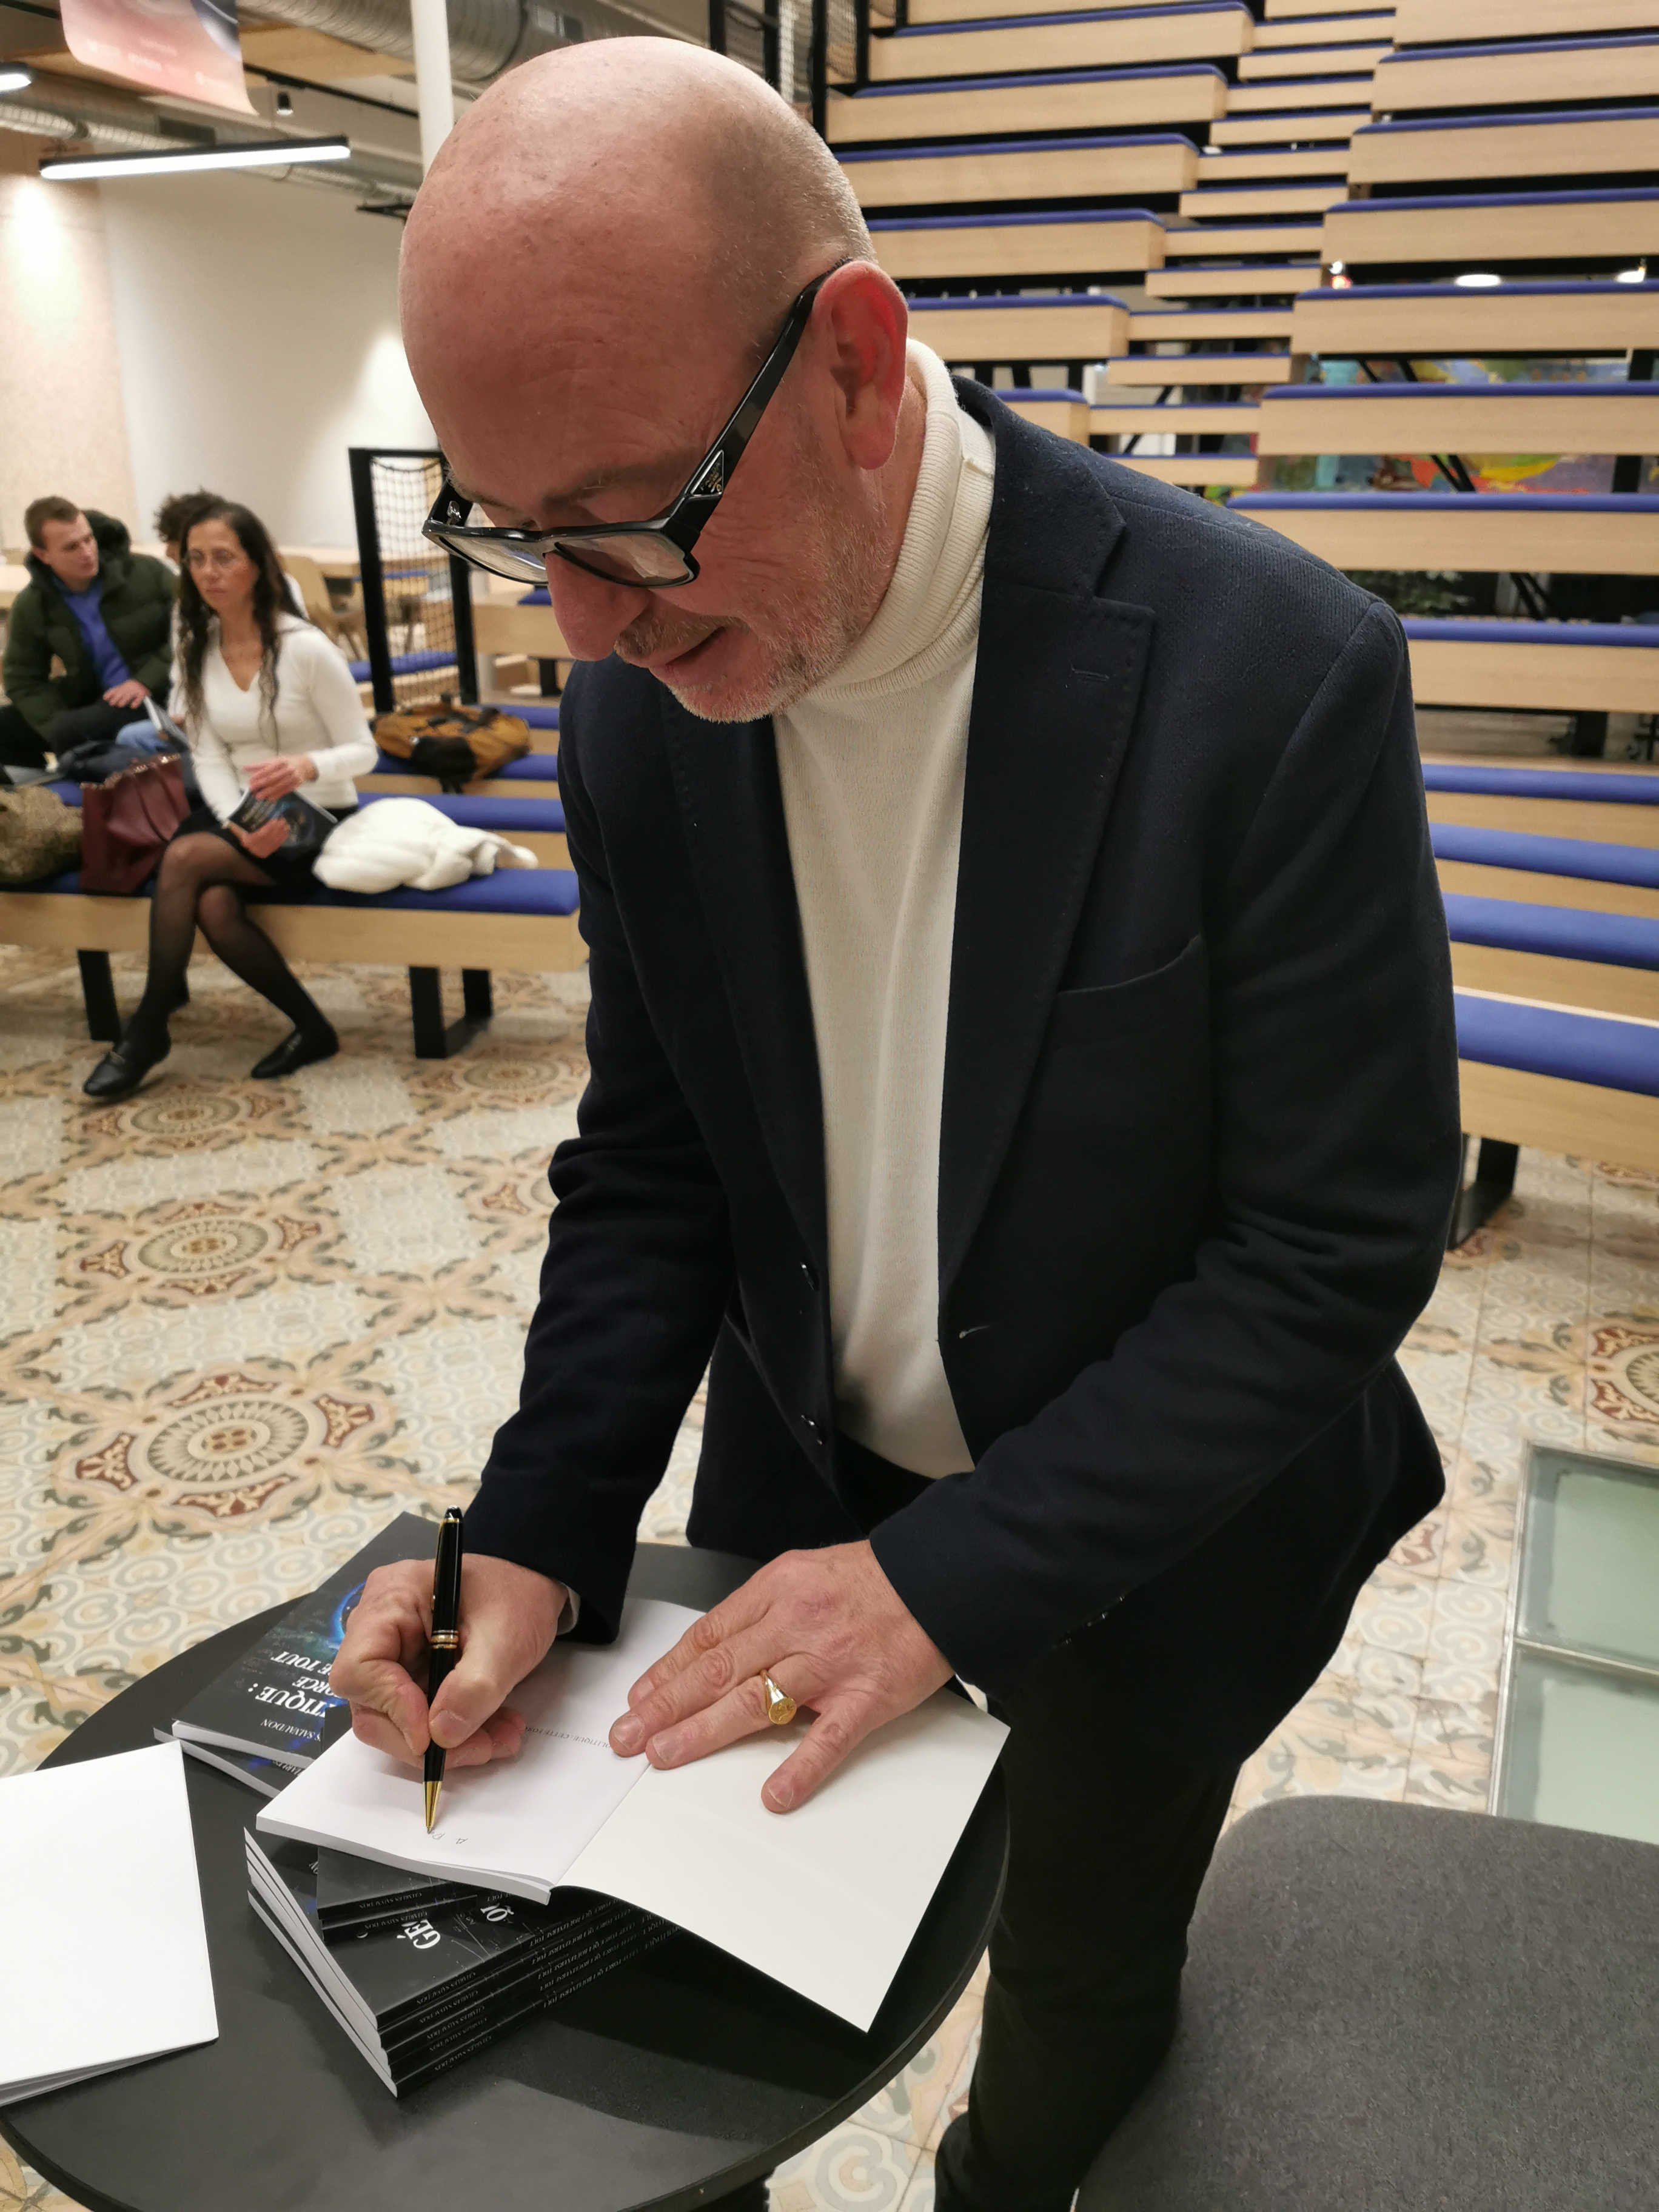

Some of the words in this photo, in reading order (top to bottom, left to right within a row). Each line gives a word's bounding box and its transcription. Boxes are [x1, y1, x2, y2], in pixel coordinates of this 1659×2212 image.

[271, 1651, 321, 1672] TOUT
[255, 1686, 329, 1718] TIQUE
[261, 1718, 313, 1740] SALVAUDON
